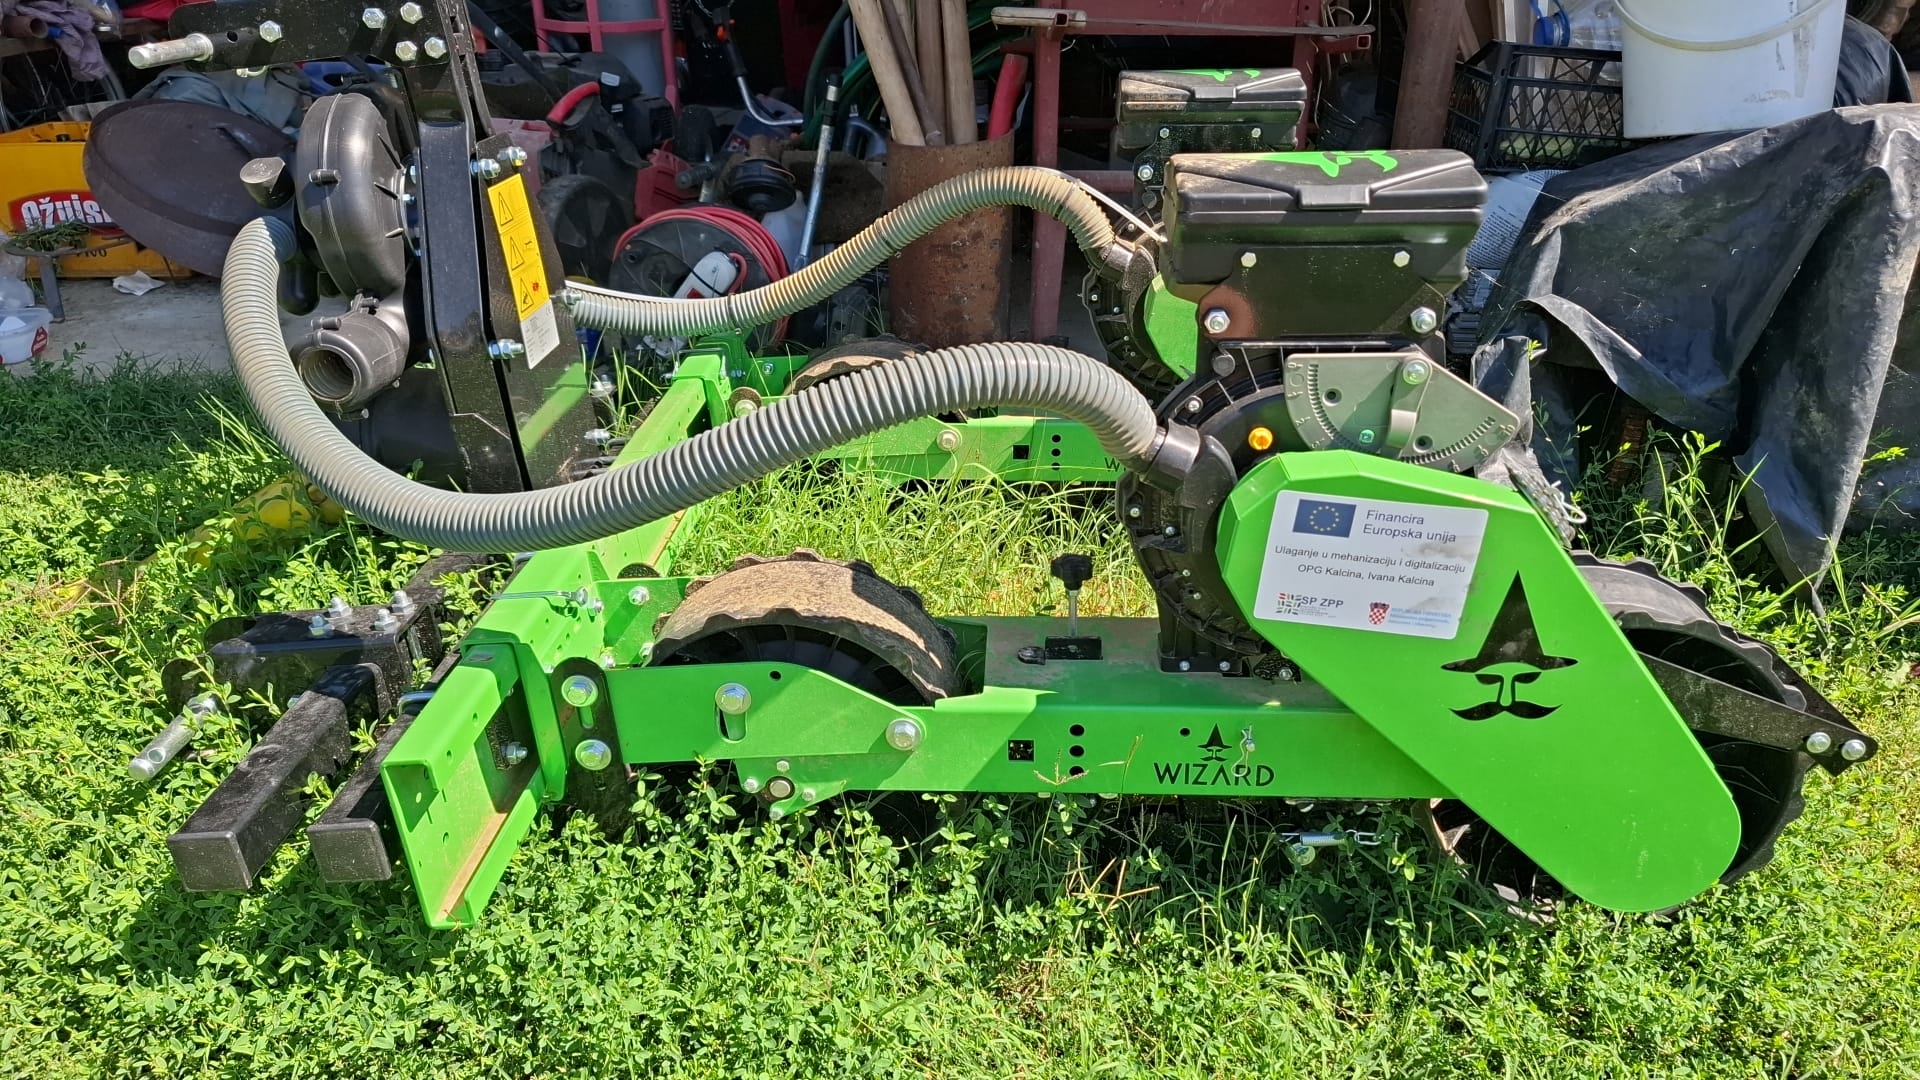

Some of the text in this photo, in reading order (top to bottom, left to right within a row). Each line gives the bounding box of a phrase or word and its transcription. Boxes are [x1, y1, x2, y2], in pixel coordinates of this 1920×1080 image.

[1366, 509, 1425, 525] Financira
[1363, 523, 1457, 544] Europska unija
[1275, 545, 1319, 558] Ulaganje
[1321, 551, 1328, 559] u
[1330, 551, 1397, 568] mehanizaciju
[1404, 559, 1466, 574] digitalizaciju
[1297, 563, 1435, 587] OPG Kalcina, Ivana Kalcina
[1300, 596, 1344, 608] SP ZPP
[1154, 762, 1275, 787] WIZARD
